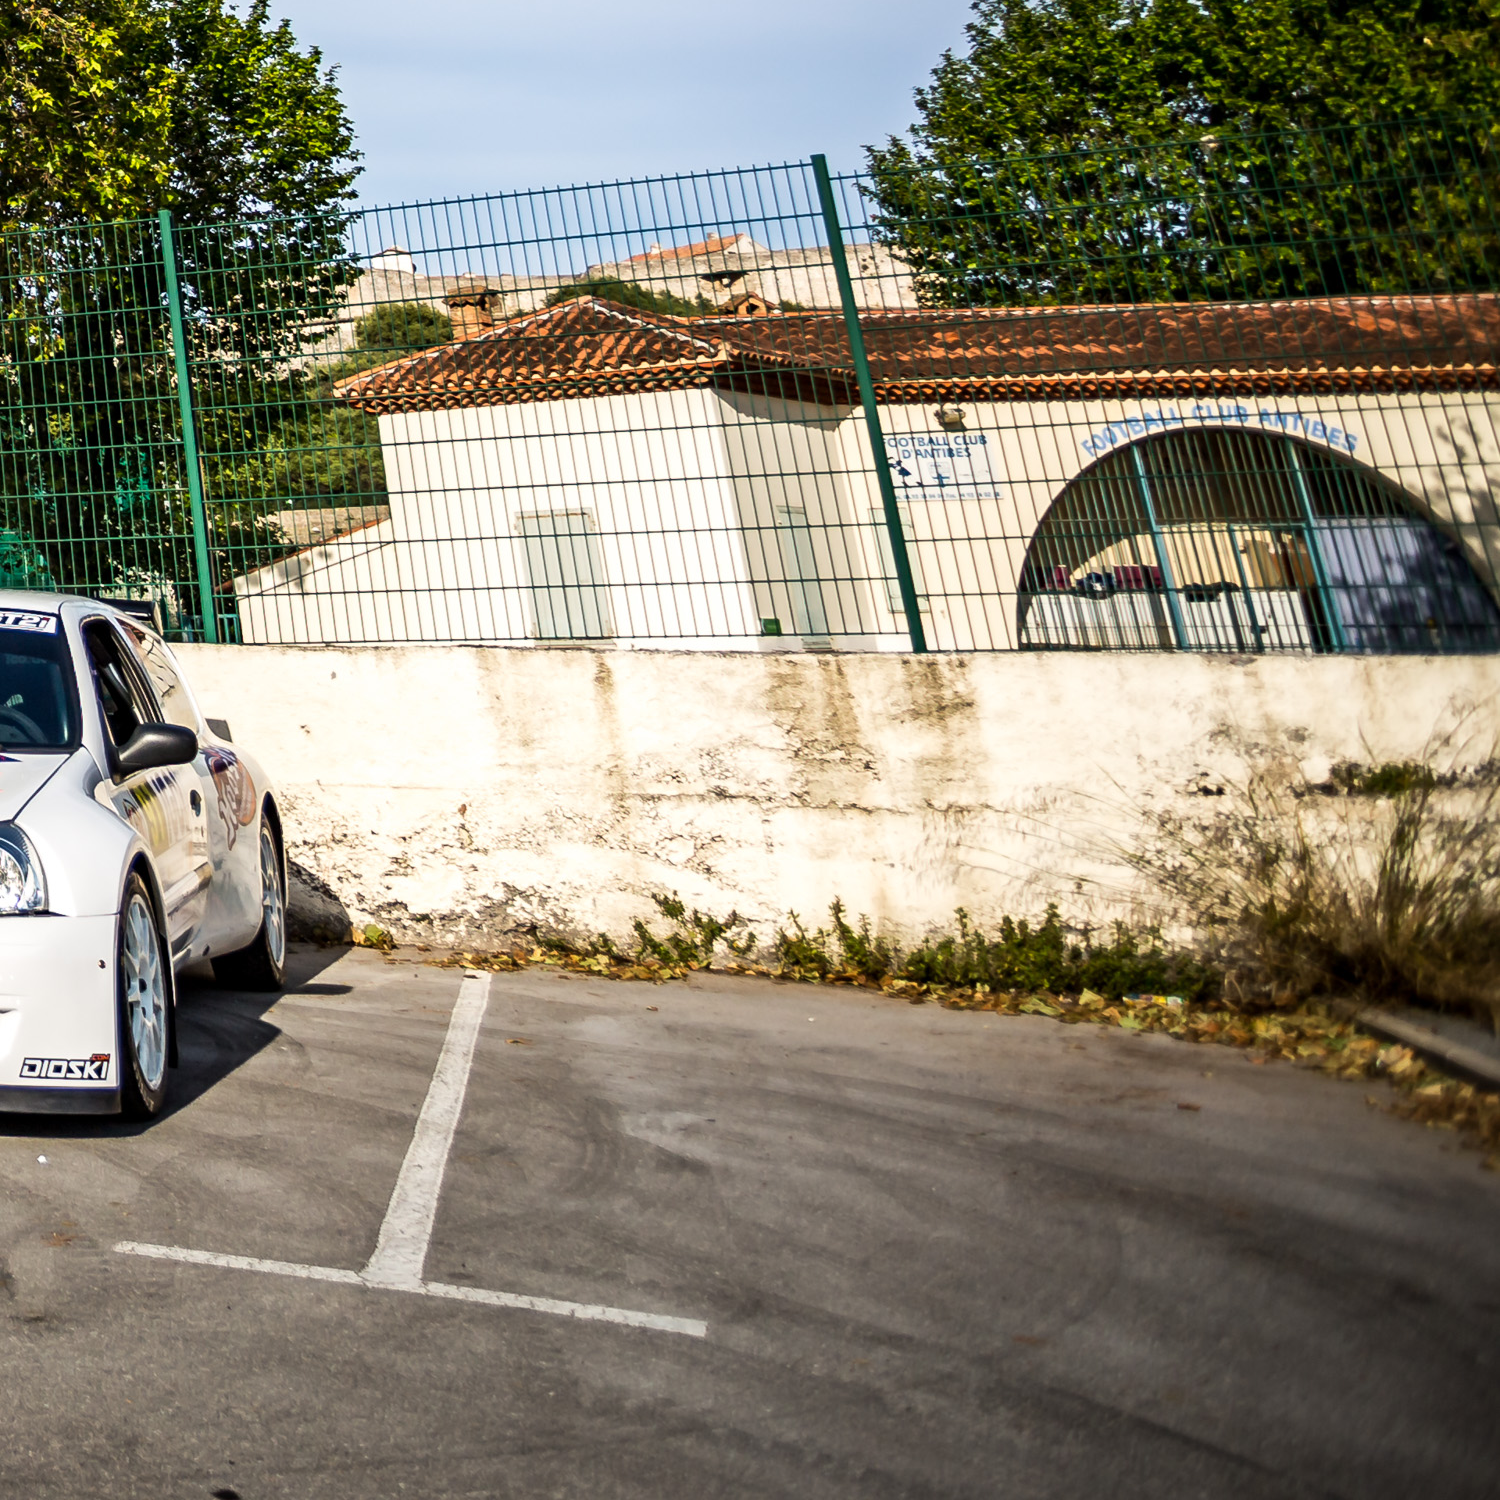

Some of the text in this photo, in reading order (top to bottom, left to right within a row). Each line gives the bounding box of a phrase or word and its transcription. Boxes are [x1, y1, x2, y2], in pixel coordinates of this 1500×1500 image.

[1080, 404, 1360, 457] FOOTBALL CLUB ANTIBES
[884, 434, 988, 448] OOTBALL CLUB
[901, 447, 972, 459] D'ANTIBES
[20, 1058, 108, 1080] DIOSKI
